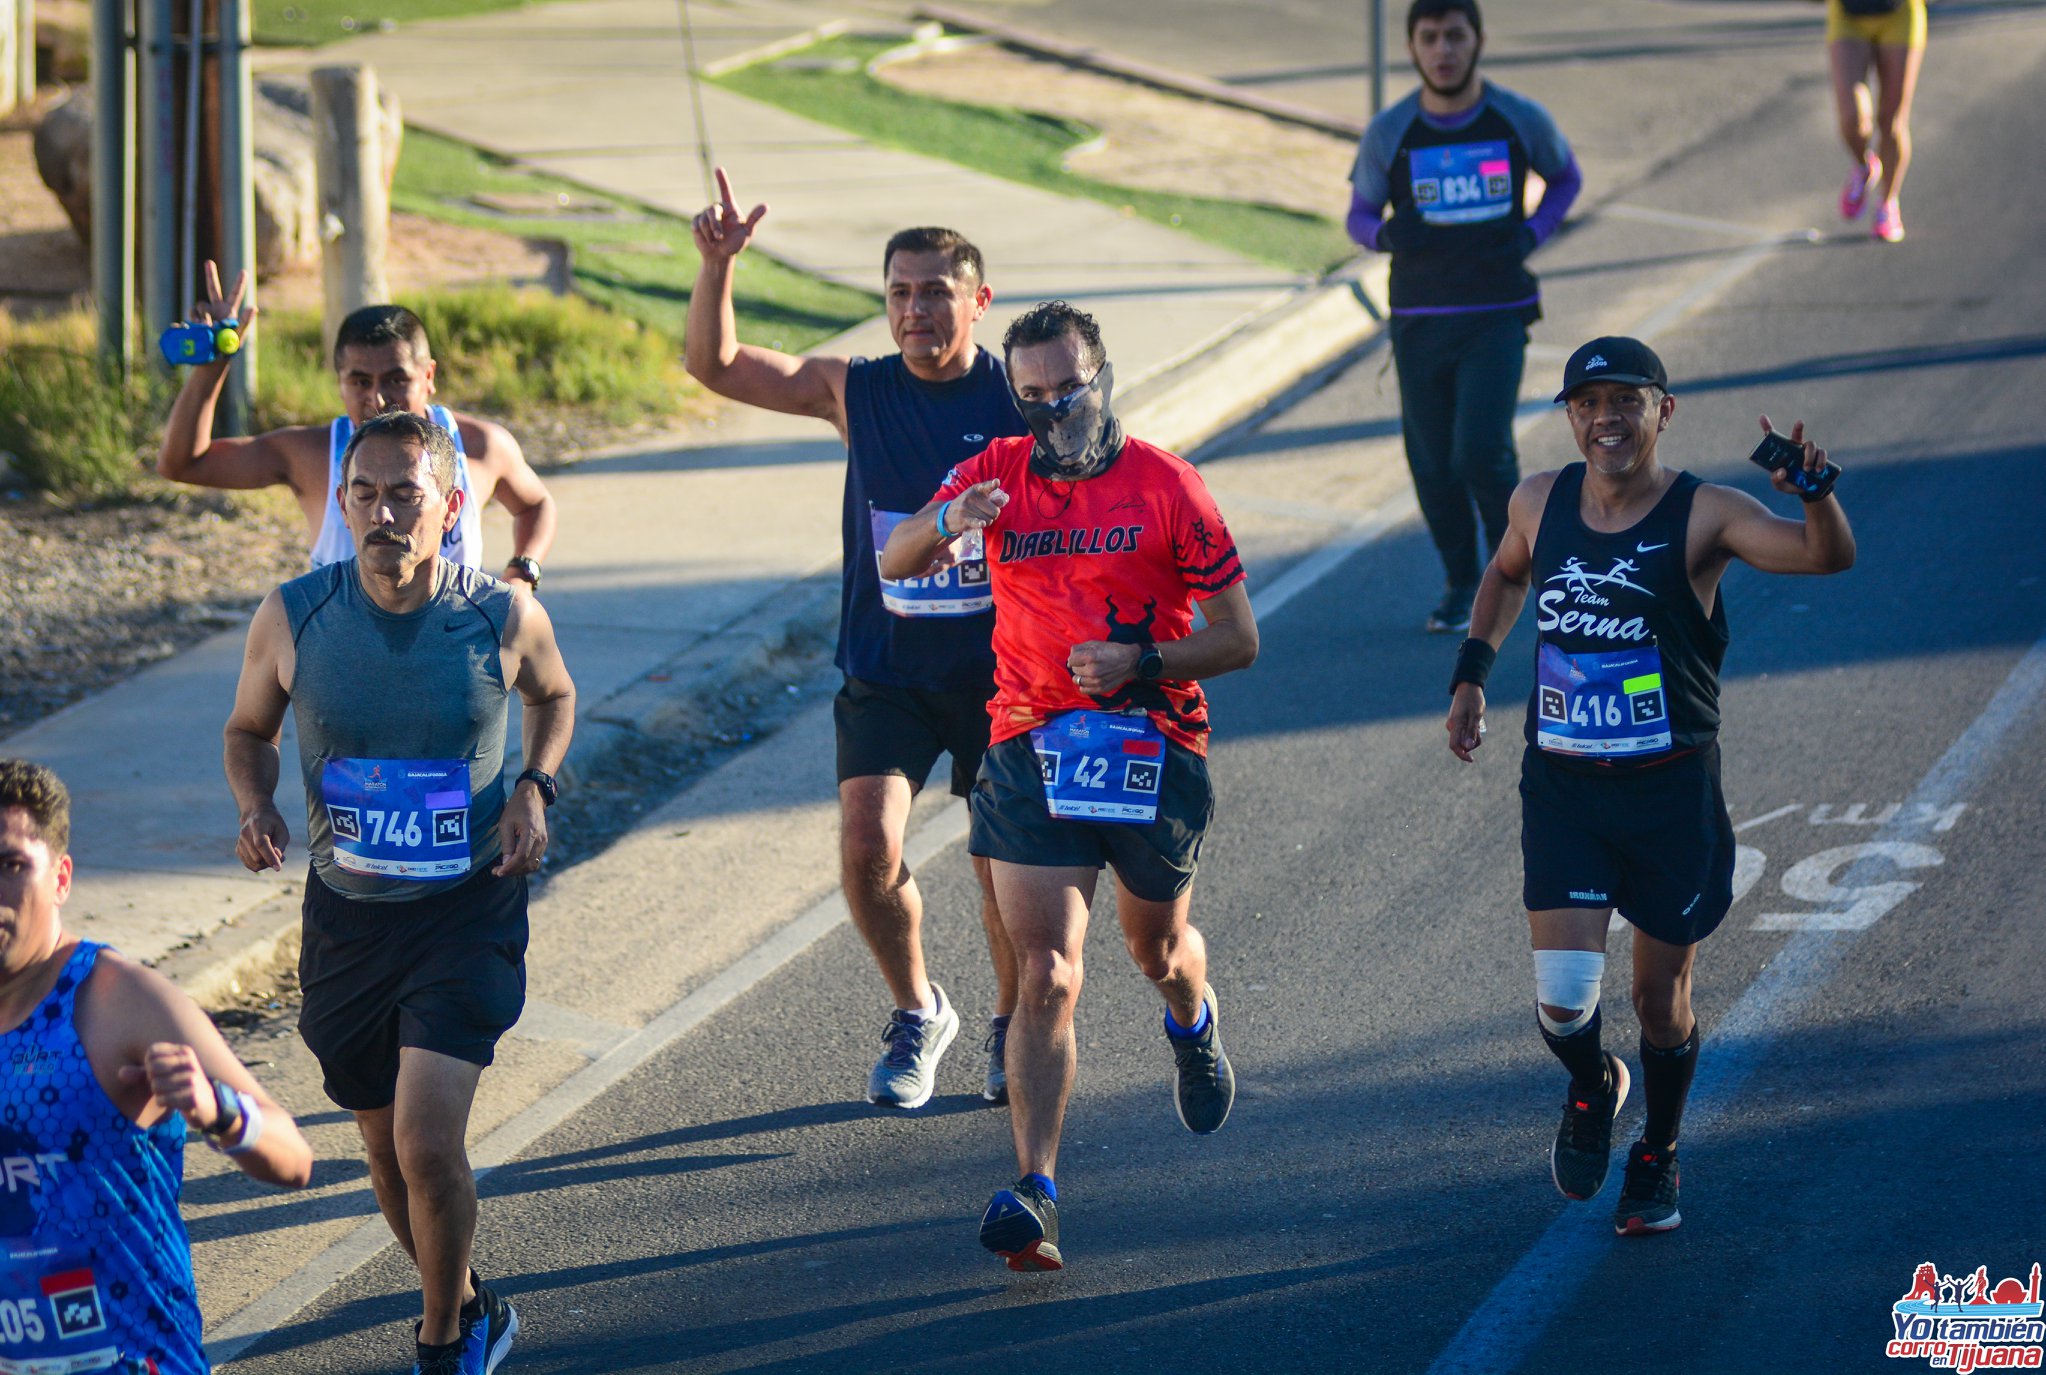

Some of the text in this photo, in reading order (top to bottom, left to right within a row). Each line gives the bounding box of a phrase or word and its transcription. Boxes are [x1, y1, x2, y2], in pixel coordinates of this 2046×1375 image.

[999, 525, 1144, 564] DIABLILLOS
[1571, 586, 1610, 607] Team
[1537, 590, 1649, 641] Serna
[1571, 695, 1622, 727] 416
[1073, 755, 1109, 789] 42
[366, 810, 423, 847] 746
[0, 1298, 46, 1343] 05
